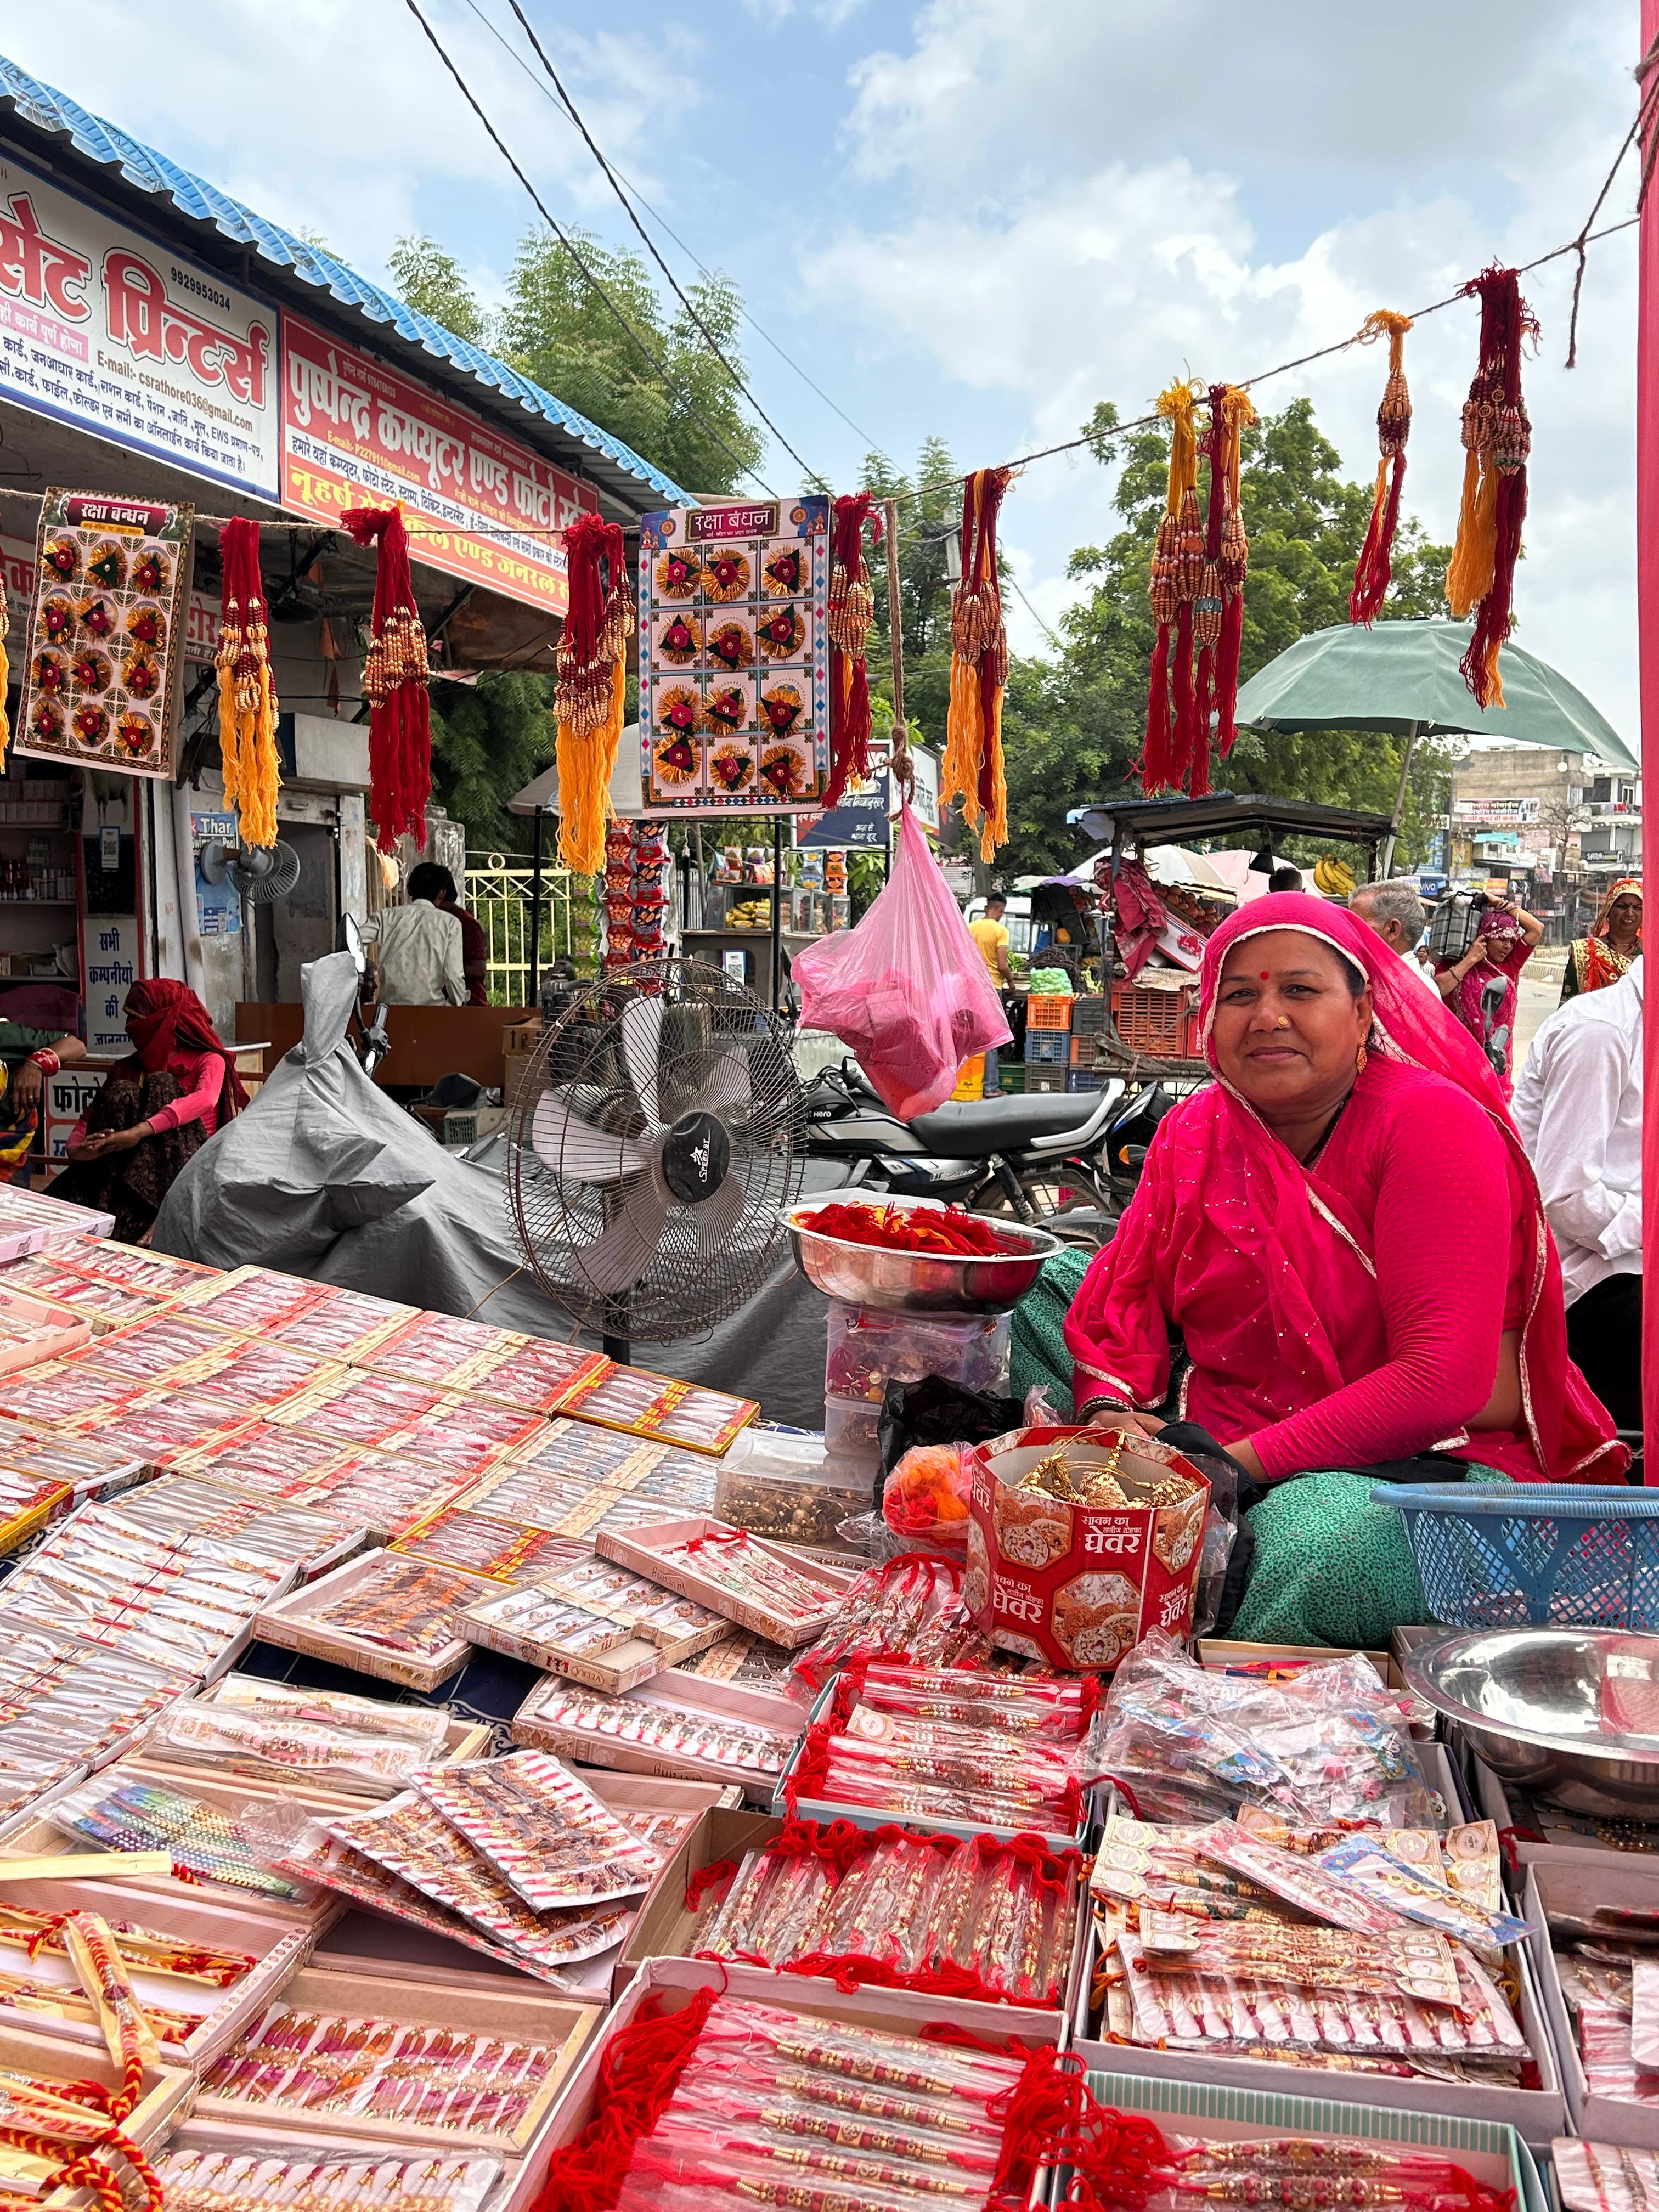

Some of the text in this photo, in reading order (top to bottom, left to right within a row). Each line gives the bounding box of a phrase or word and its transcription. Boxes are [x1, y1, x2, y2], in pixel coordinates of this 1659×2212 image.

[171, 267, 230, 311] 9929953034
[41, 323, 58, 347] पूर्ण
[101, 247, 270, 410] प्रिन्टर्स
[139, 373, 253, 432] csrathore036@gmail.com
[212, 427, 229, 444] EWS
[292, 435, 311, 459] हमारे
[363, 464, 379, 488] फोटो
[469, 447, 509, 506] एण्ड
[513, 462, 556, 530] फोटो
[81, 503, 151, 526] रक्षा बन्धन
[695, 510, 771, 532] रक्षा बंधन
[495, 552, 556, 594] जनरल
[201, 817, 232, 834] Thar
[222, 837, 236, 849] Pool
[1420, 881, 1435, 891] vivo
[100, 927, 120, 951] सभी
[105, 994, 119, 1018] की
[1082, 1515, 1130, 1527] सावन का
[1084, 1525, 1142, 1554] घेवर
[1017, 1578, 1031, 1593] का
[993, 1583, 1044, 1624] घेवर
[1160, 1594, 1187, 1628] घेवर
[577, 1668, 601, 1683] VEERA
